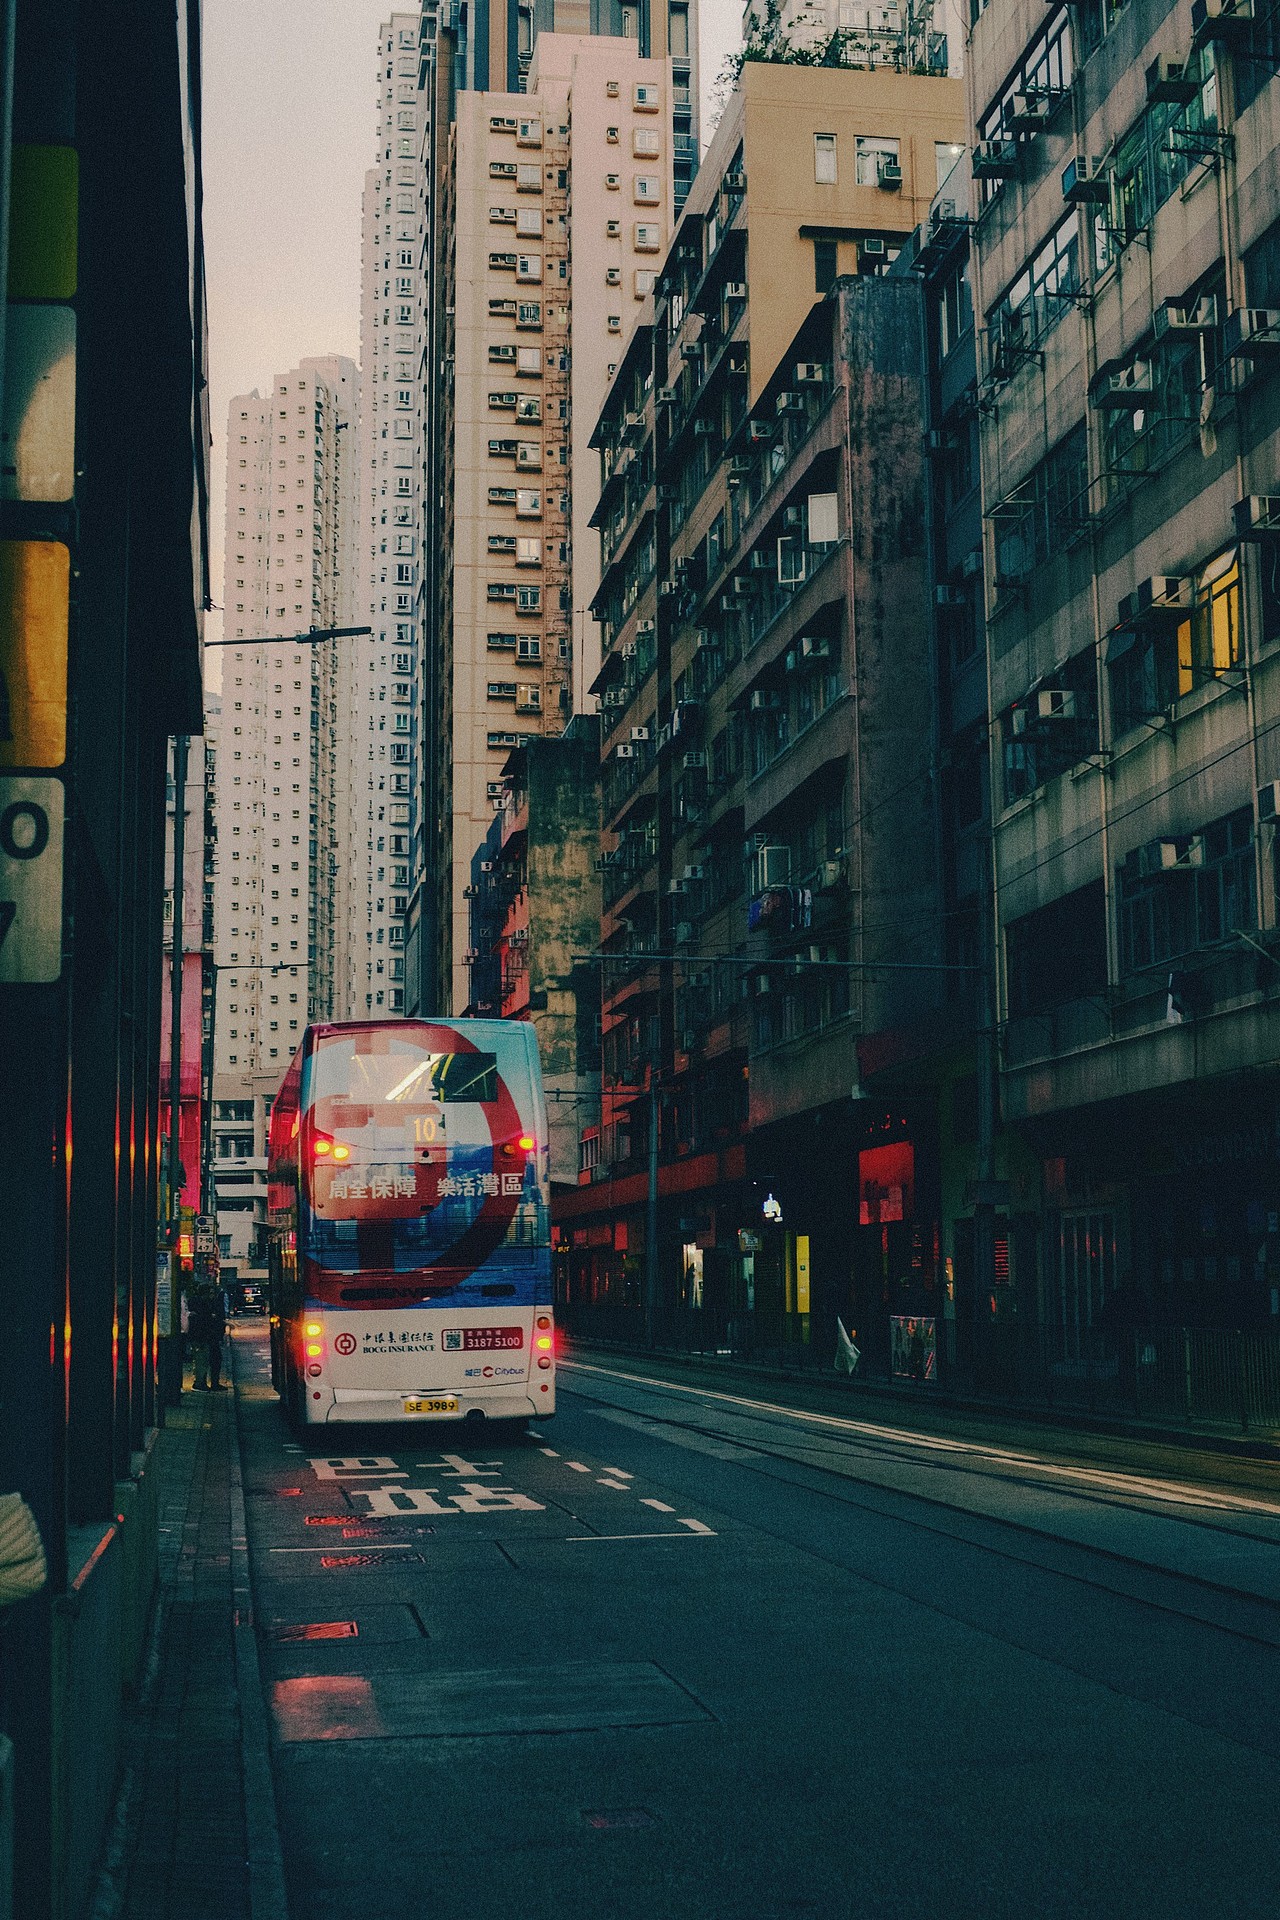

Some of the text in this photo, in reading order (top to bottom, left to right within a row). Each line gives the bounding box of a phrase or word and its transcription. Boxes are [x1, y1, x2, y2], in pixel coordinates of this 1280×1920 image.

[414, 1117, 436, 1141] 10
[329, 1173, 524, 1199] 周全保障 樂活灣區
[363, 1344, 435, 1354] BOCG INSURANCE
[467, 1337, 520, 1348] 3187 5100
[409, 1401, 455, 1411] SE 3989
[305, 1454, 503, 1481] 巴士
[351, 1483, 546, 1518] 站
